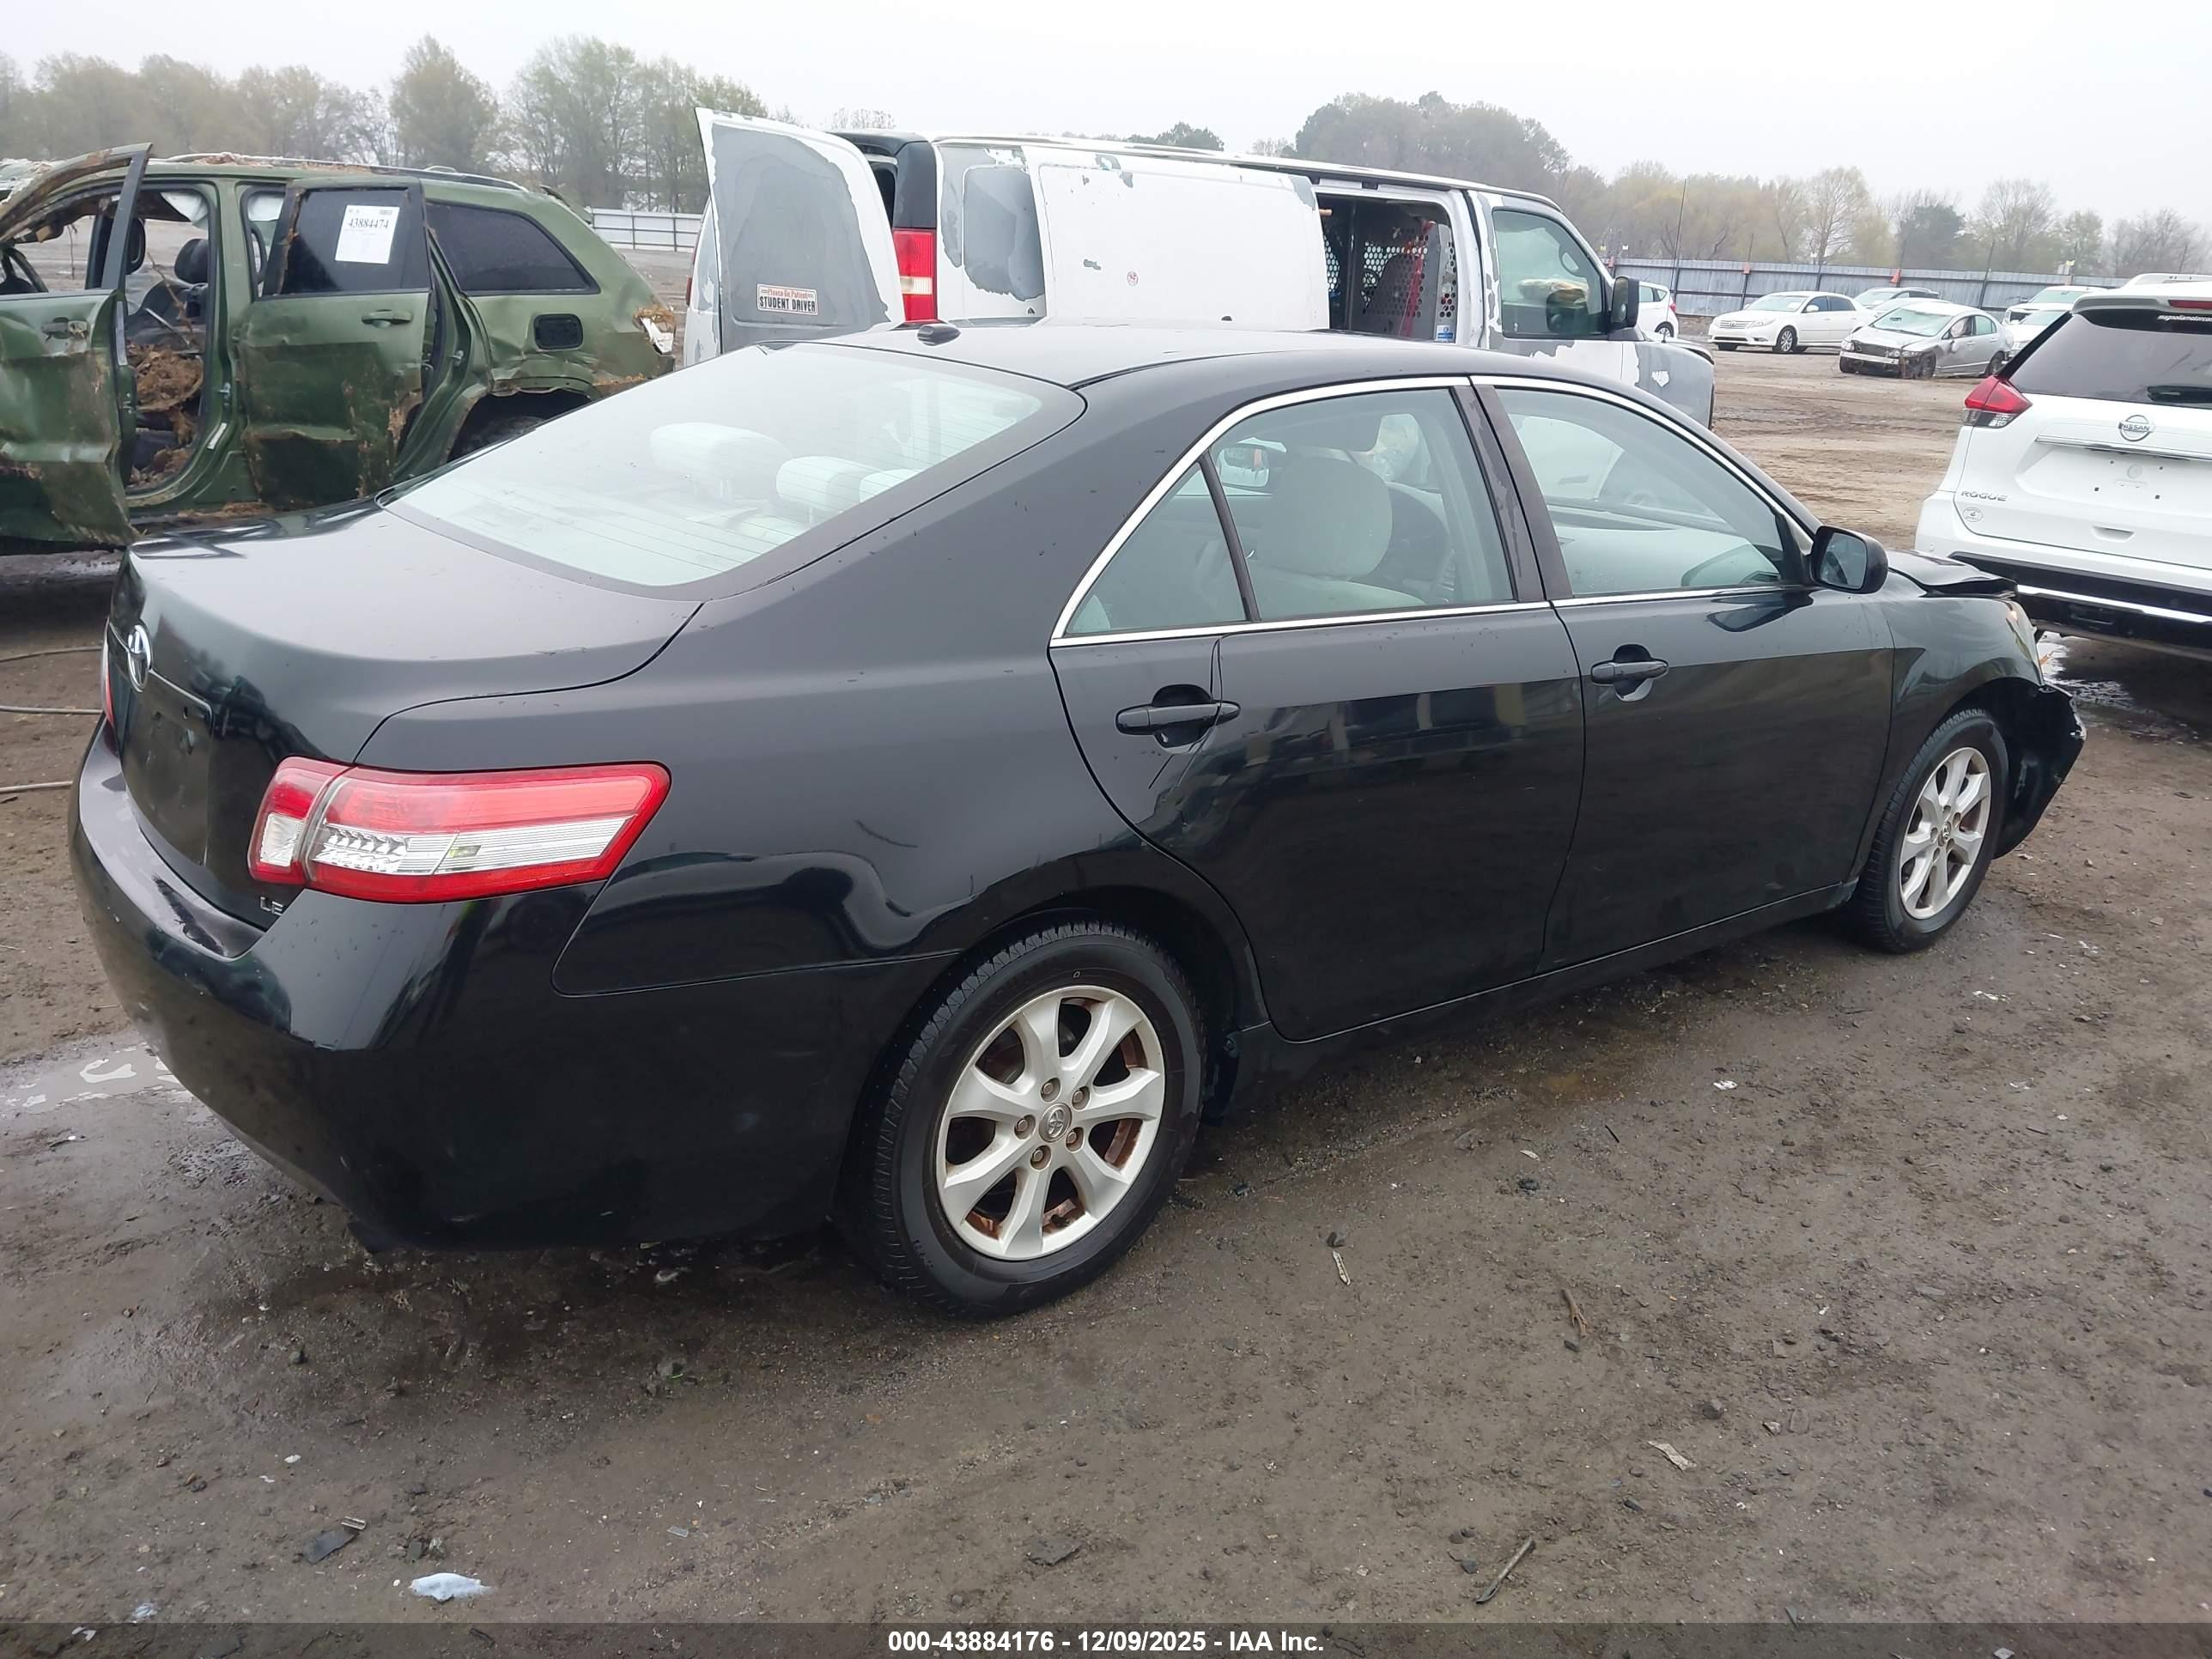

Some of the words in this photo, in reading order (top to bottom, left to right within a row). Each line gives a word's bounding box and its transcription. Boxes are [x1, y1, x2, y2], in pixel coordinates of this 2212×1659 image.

[348, 217, 389, 229] 43884474
[759, 296, 789, 309] STUDENT
[792, 299, 816, 313] DRIVER
[1960, 490, 2008, 501] ROGUE
[260, 896, 283, 916] LE
